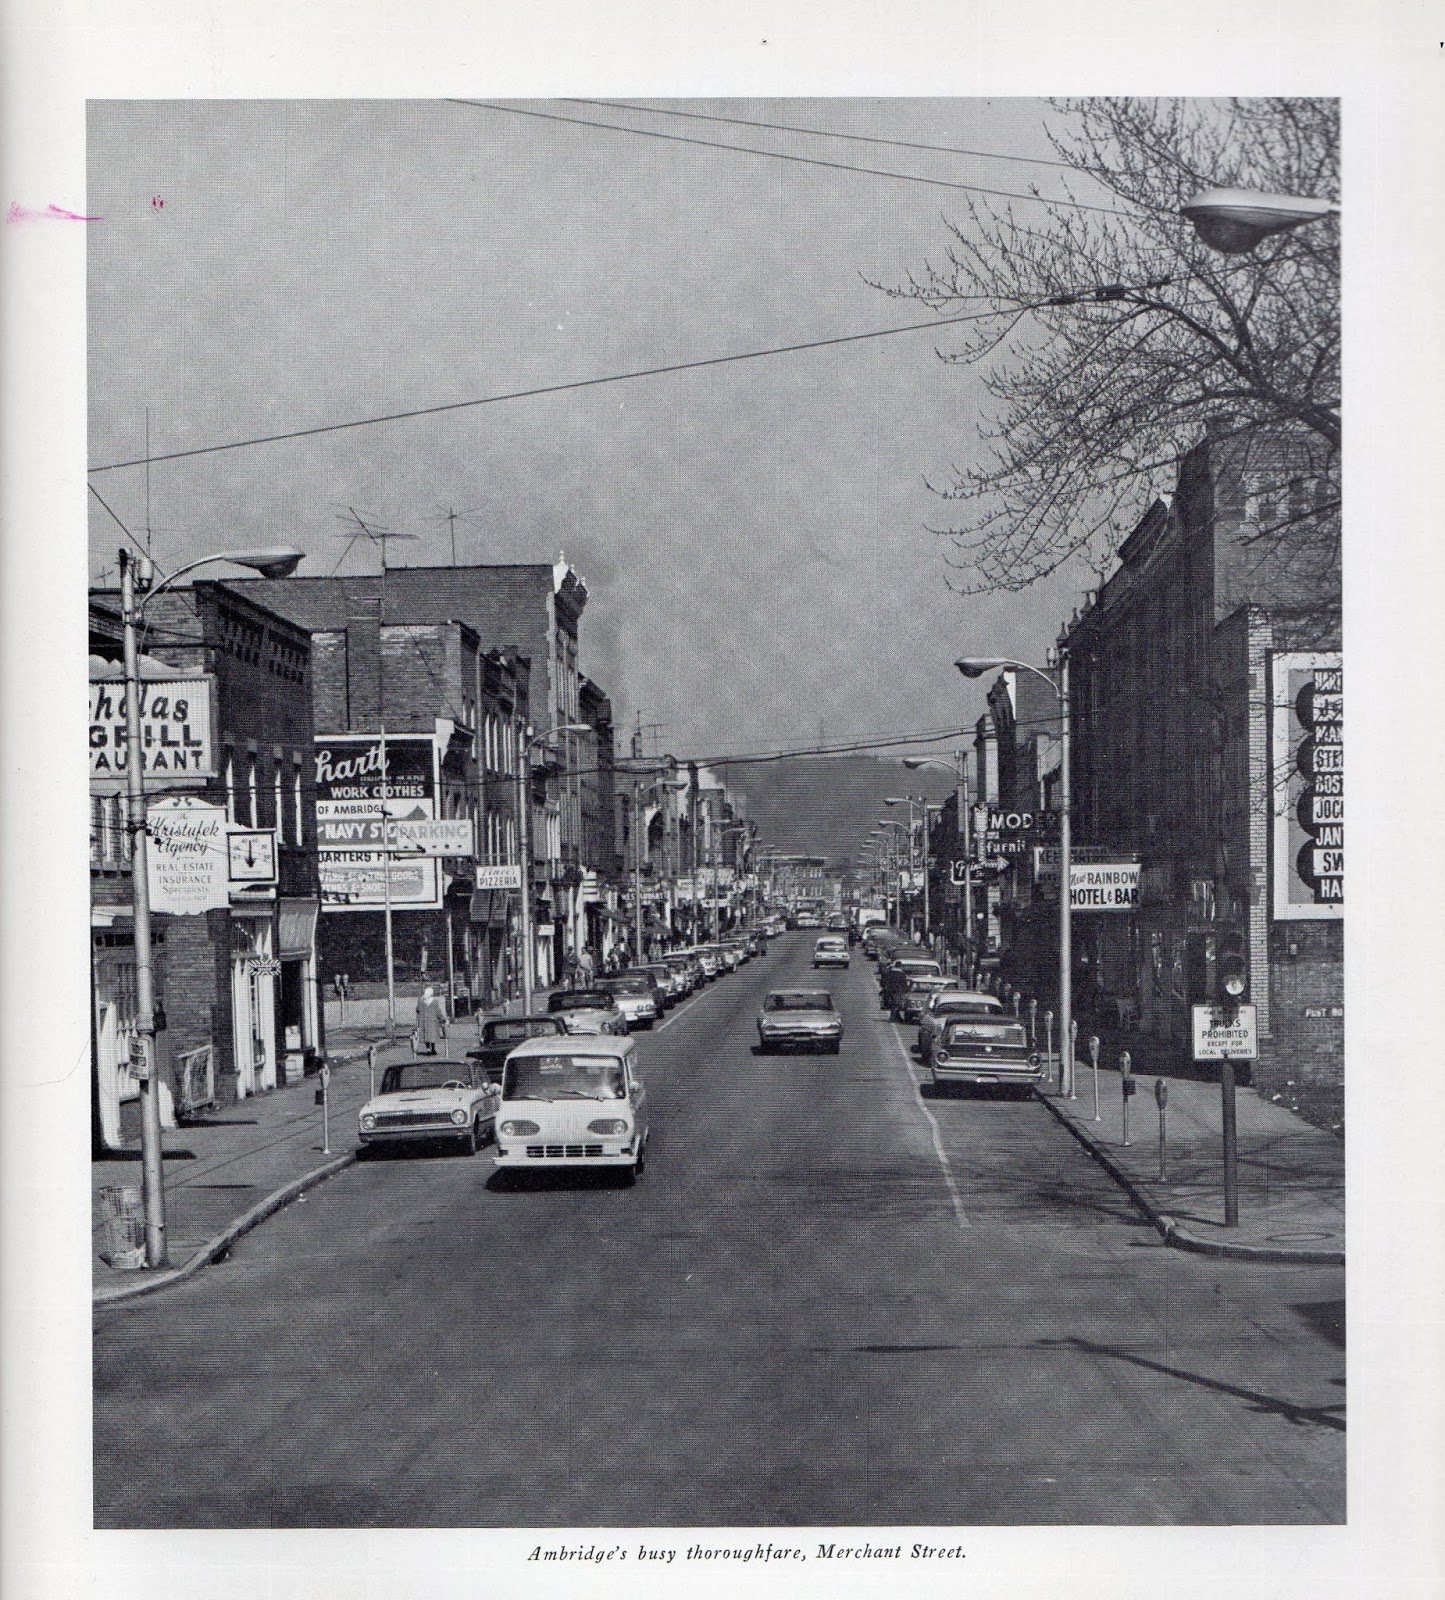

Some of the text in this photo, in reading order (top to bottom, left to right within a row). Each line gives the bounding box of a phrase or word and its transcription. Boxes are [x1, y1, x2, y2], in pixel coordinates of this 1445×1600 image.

[89, 684, 189, 723] holas
[89, 751, 203, 771] AURANT
[1315, 749, 1343, 768] STE
[331, 786, 369, 798] WORK
[318, 805, 330, 814] OF
[325, 823, 366, 839] NAVY
[400, 825, 469, 840] PARKING
[1315, 827, 1343, 846] JAN
[159, 875, 211, 884] INSURANCE
[479, 876, 518, 887] PIZZERIA
[1087, 872, 1139, 885] RAINBOW
[1070, 888, 1106, 905] HOTEL
[1115, 888, 1139, 904] BAR
[1320, 879, 1343, 899] HA
[1202, 1030, 1248, 1039] PROHIBITED
